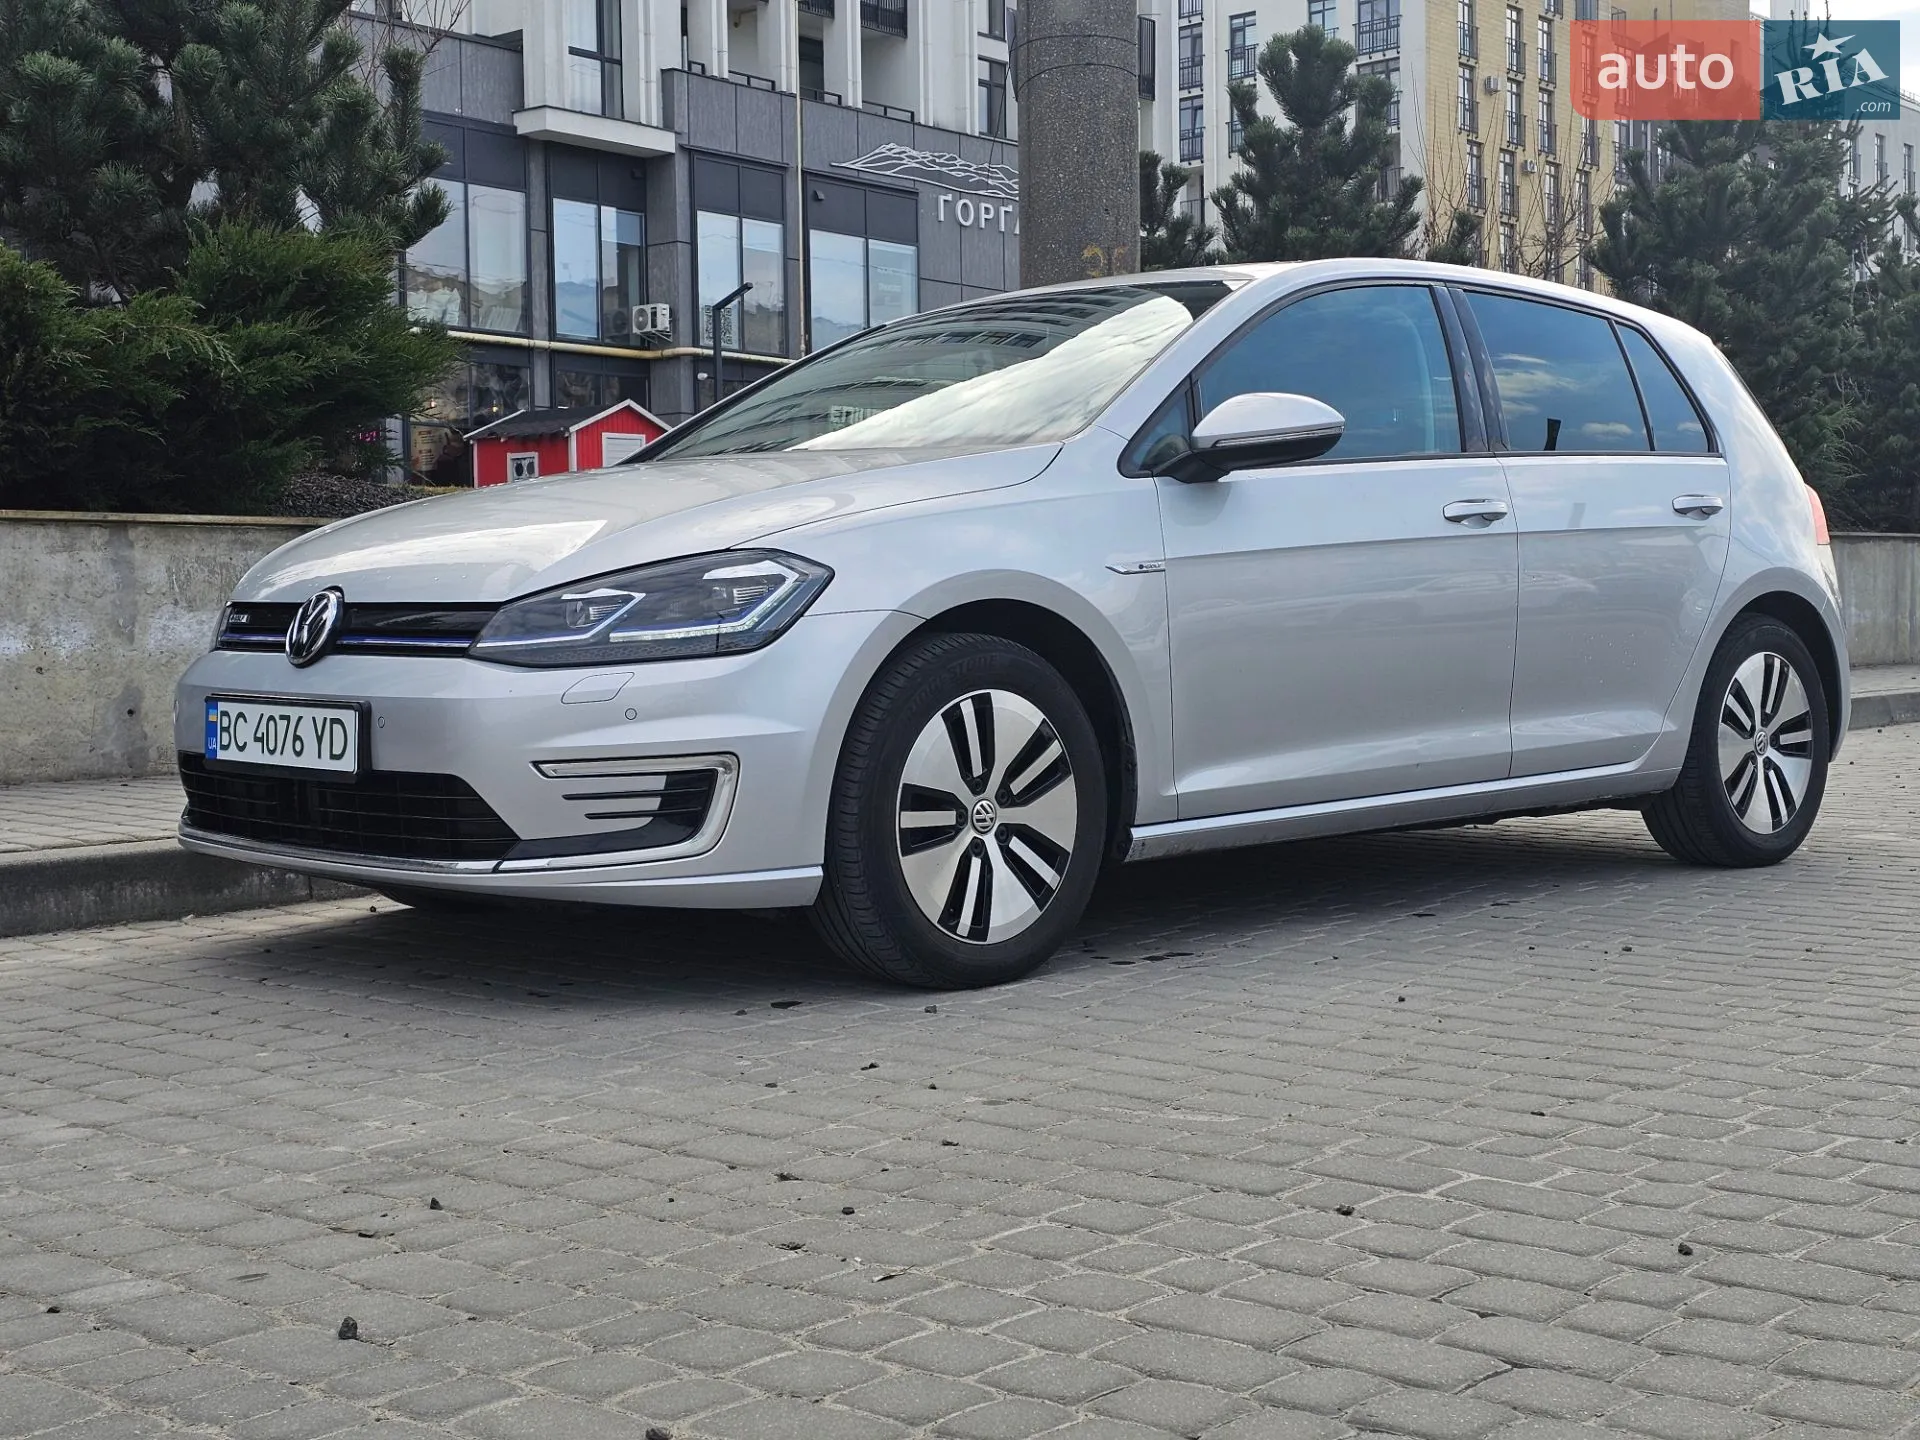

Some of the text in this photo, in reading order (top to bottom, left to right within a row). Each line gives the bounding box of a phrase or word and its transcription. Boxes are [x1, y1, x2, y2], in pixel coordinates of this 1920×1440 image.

[937, 193, 1020, 235] ҐОРҐ
[208, 737, 217, 750] UA
[219, 710, 348, 761] BC 4076 YD
